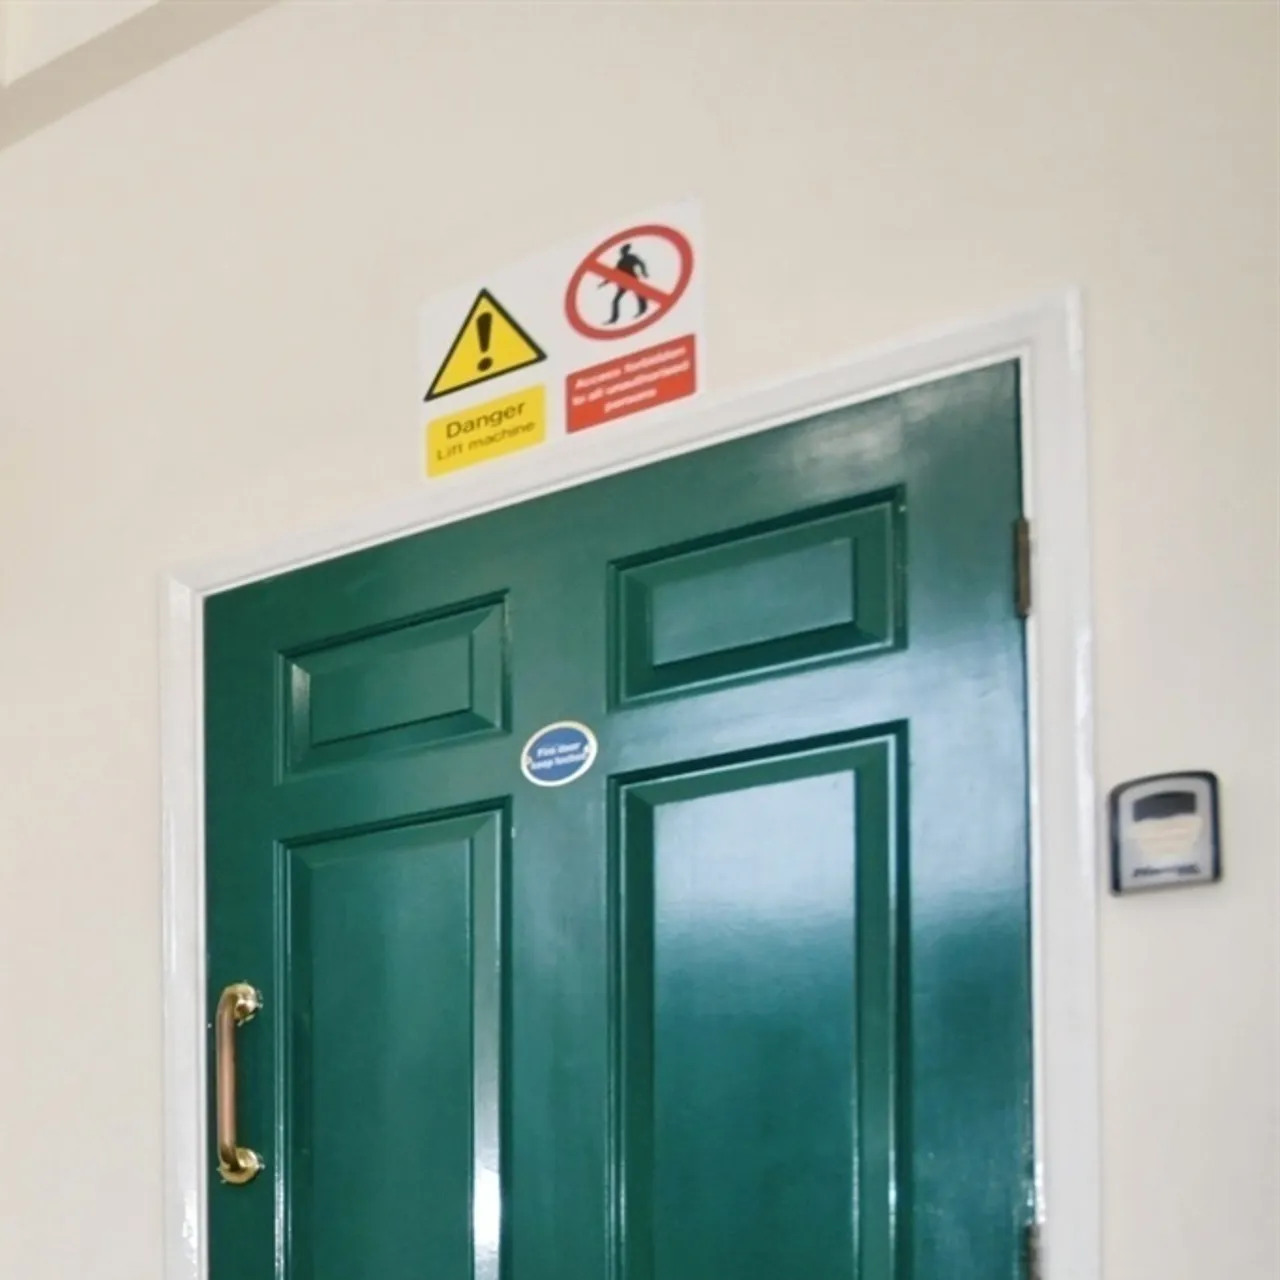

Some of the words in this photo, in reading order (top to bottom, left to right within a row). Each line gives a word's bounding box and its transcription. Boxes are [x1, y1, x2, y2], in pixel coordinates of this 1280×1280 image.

[446, 402, 526, 439] Danger
[436, 444, 464, 461] Lift
[468, 421, 536, 451] machine
